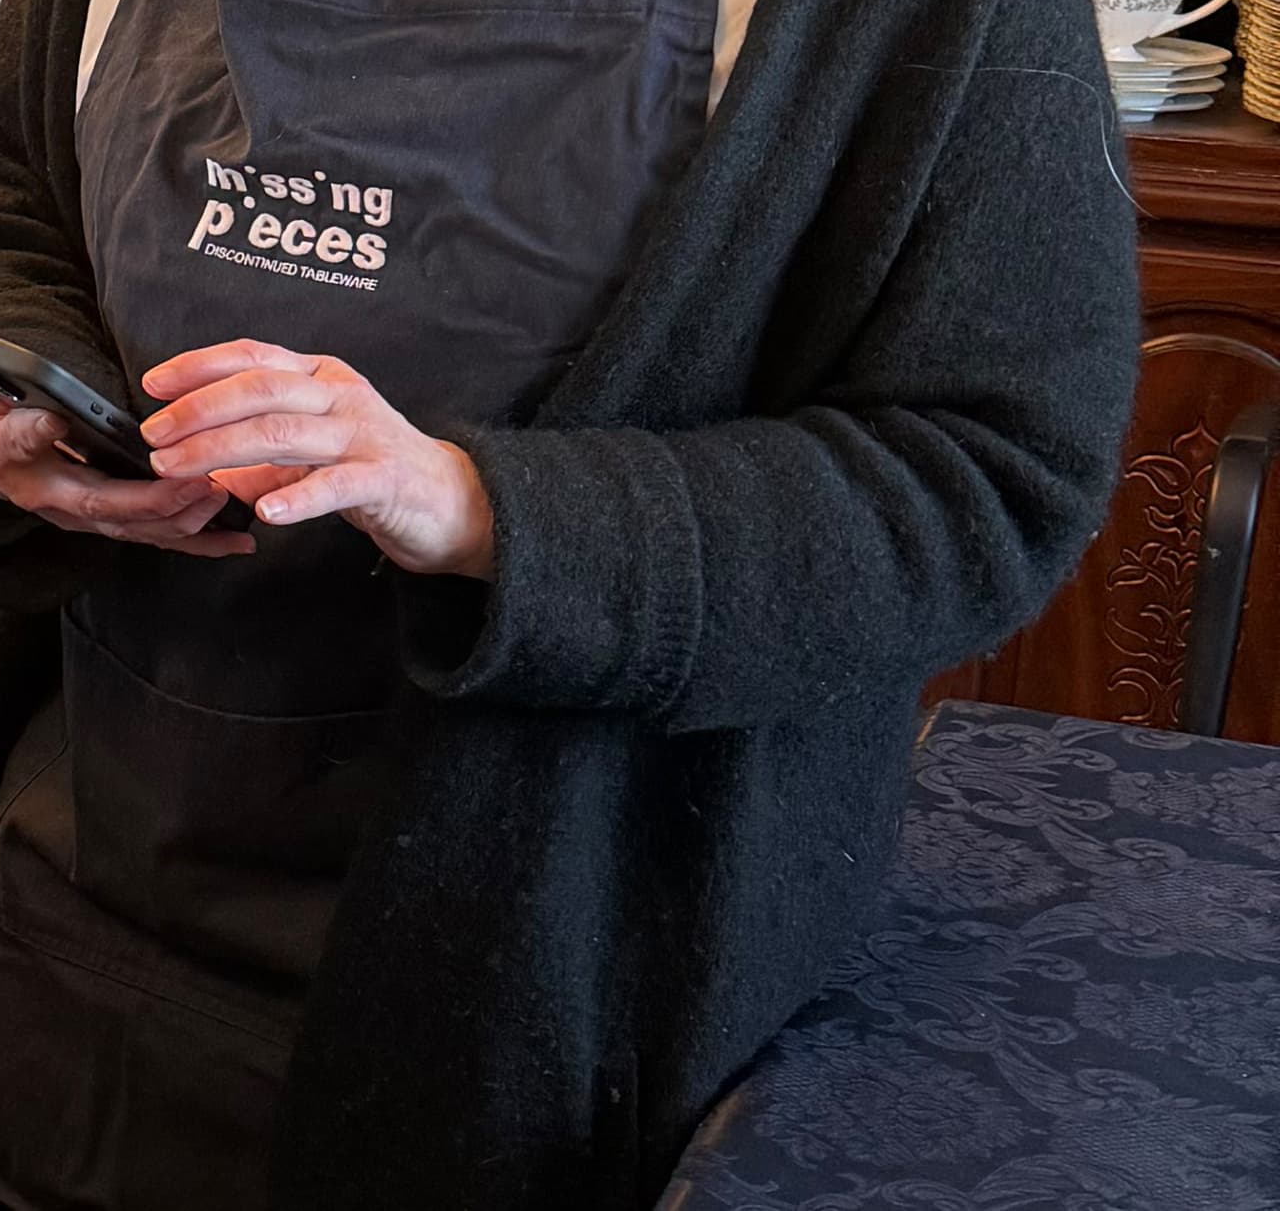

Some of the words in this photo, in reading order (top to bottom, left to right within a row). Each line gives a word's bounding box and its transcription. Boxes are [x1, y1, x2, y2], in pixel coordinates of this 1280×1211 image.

[206, 158, 393, 227] mssng
[188, 196, 388, 271] peces
[204, 243, 298, 276] DISCONTINUED
[300, 266, 379, 292] TABLEWARE
